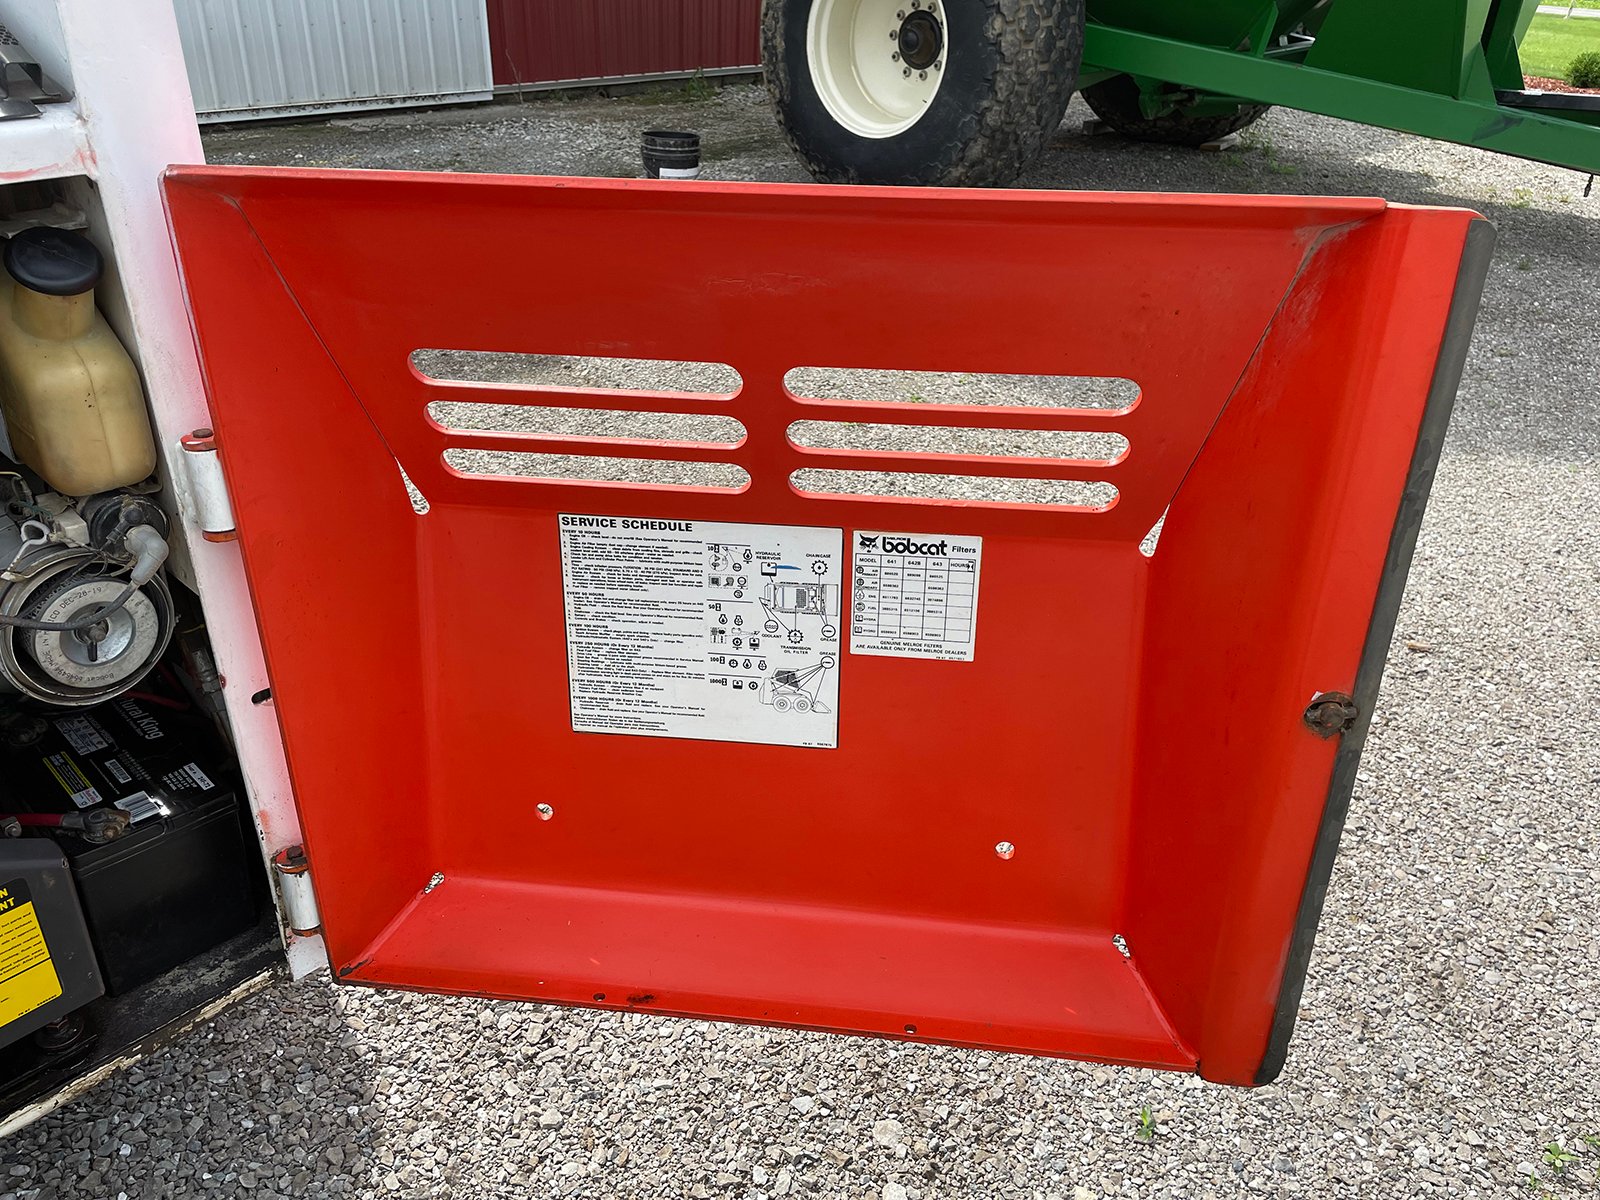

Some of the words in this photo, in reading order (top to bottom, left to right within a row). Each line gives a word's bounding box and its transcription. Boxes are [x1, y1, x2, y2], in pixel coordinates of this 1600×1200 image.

[562, 516, 617, 528] SERVICE
[622, 519, 692, 532] SCHEDULE
[882, 537, 948, 556] bobcat
[59, 586, 101, 609] DEC-28-19
[137, 717, 164, 739] King
